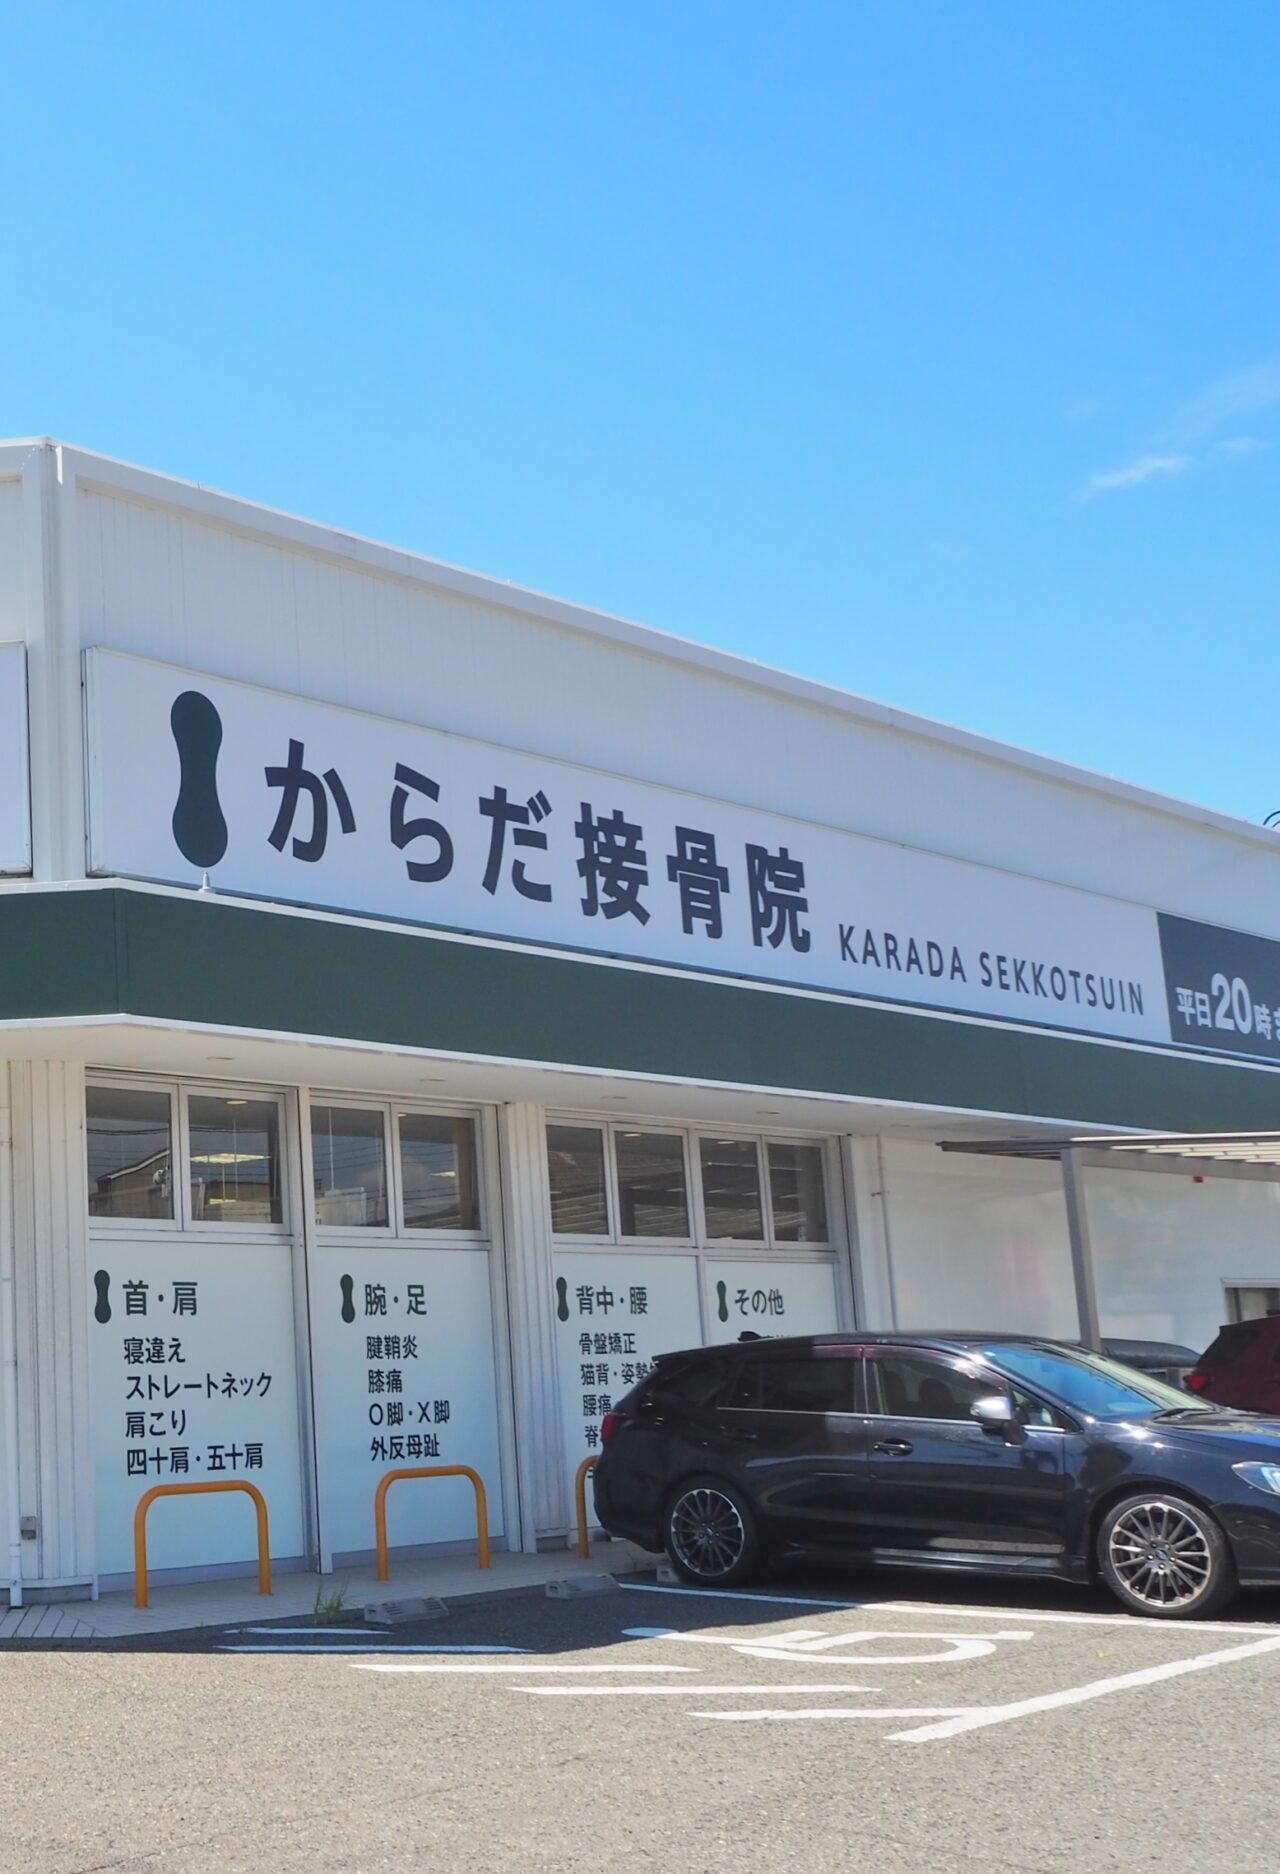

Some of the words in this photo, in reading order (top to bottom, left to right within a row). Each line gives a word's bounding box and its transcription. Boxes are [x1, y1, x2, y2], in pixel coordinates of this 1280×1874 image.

[264, 738, 812, 954] からだ接骨院
[838, 923, 966, 983] KARADA
[980, 952, 1145, 1016] SEKKOTSUIN
[122, 1279, 199, 1317] 首・肩
[364, 1283, 428, 1317] 腕・足
[575, 1285, 648, 1315] 背中・腰
[734, 1288, 785, 1316] その他
[123, 1336, 187, 1365] 寝違え
[365, 1335, 418, 1361] 腱鞘炎
[579, 1332, 637, 1356] 骨盤矯正
[125, 1371, 273, 1401] ストレートネック
[367, 1368, 403, 1394] 膝痛
[125, 1408, 187, 1439] 肩こり
[126, 1442, 265, 1477] 四十肩・五十肩
[370, 1433, 441, 1461] 外反母趾
